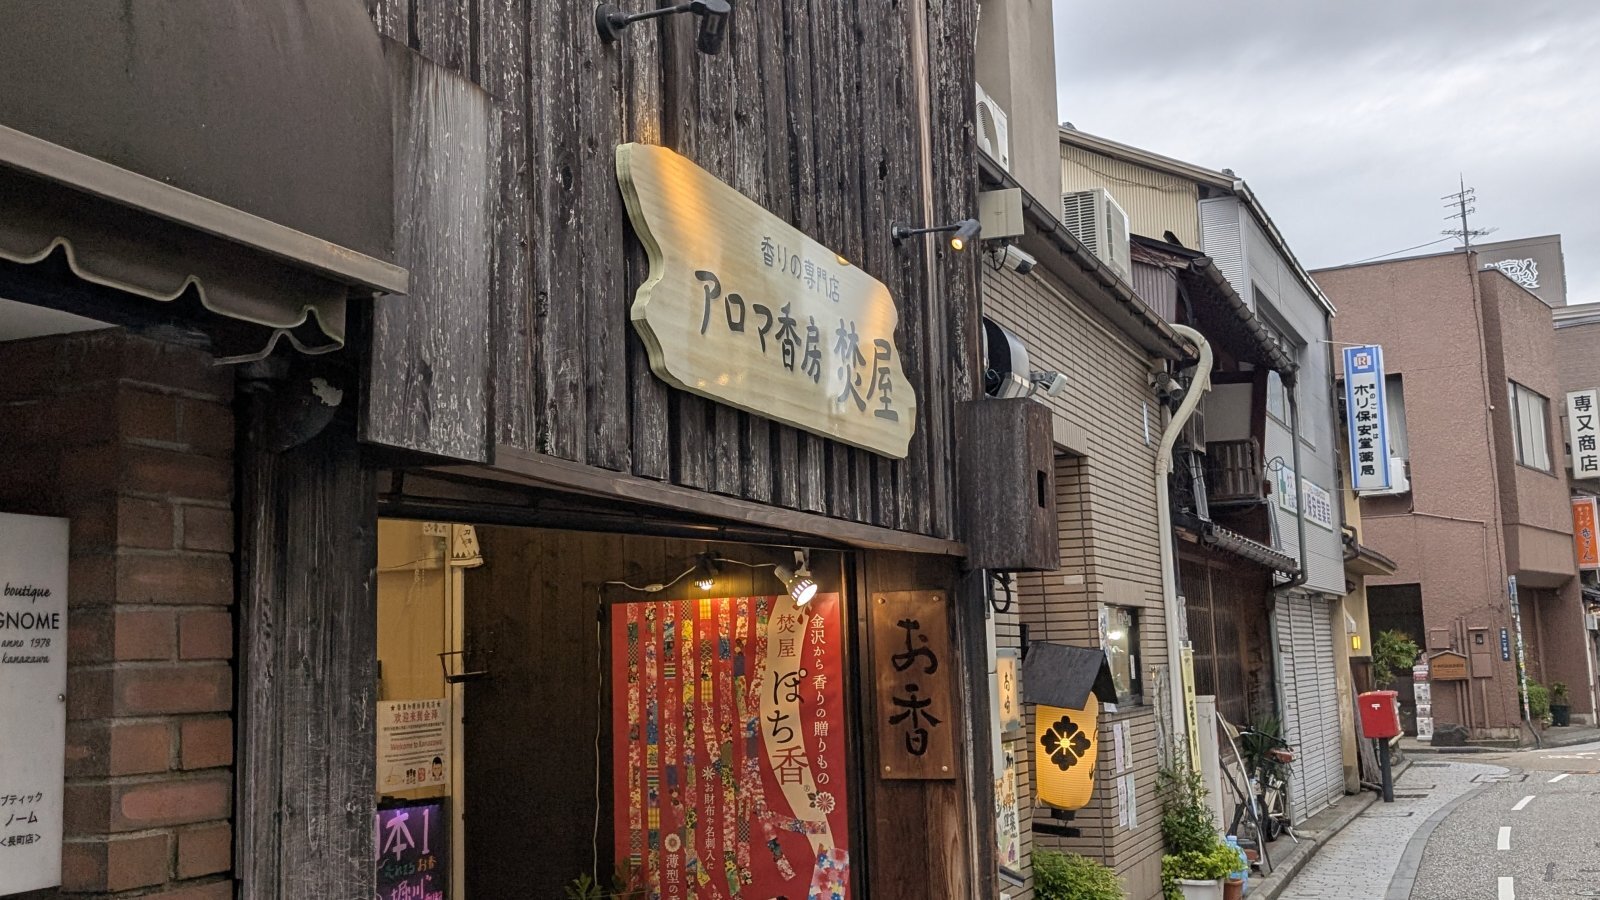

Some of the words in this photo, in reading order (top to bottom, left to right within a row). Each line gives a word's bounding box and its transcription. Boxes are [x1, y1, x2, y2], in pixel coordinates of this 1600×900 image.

[761, 236, 840, 303] 香りの専門店
[695, 270, 823, 384] アロマ香房
[834, 318, 899, 422] 焚屋
[1354, 384, 1375, 476] ホリ保安堂薬局
[1573, 395, 1599, 472] 専又商店
[4, 582, 51, 604] boutique
[1, 639, 24, 648] anno
[30, 638, 51, 648] 1978
[2, 652, 50, 663] kanazawa
[776, 613, 797, 659] 焚屋
[809, 613, 831, 785] 金沢から香りの贈りもの
[889, 618, 944, 756] お香
[767, 668, 809, 786] ぽち香
[5, 811, 38, 827] ノーム
[704, 783, 716, 870] お財布や名刺入に
